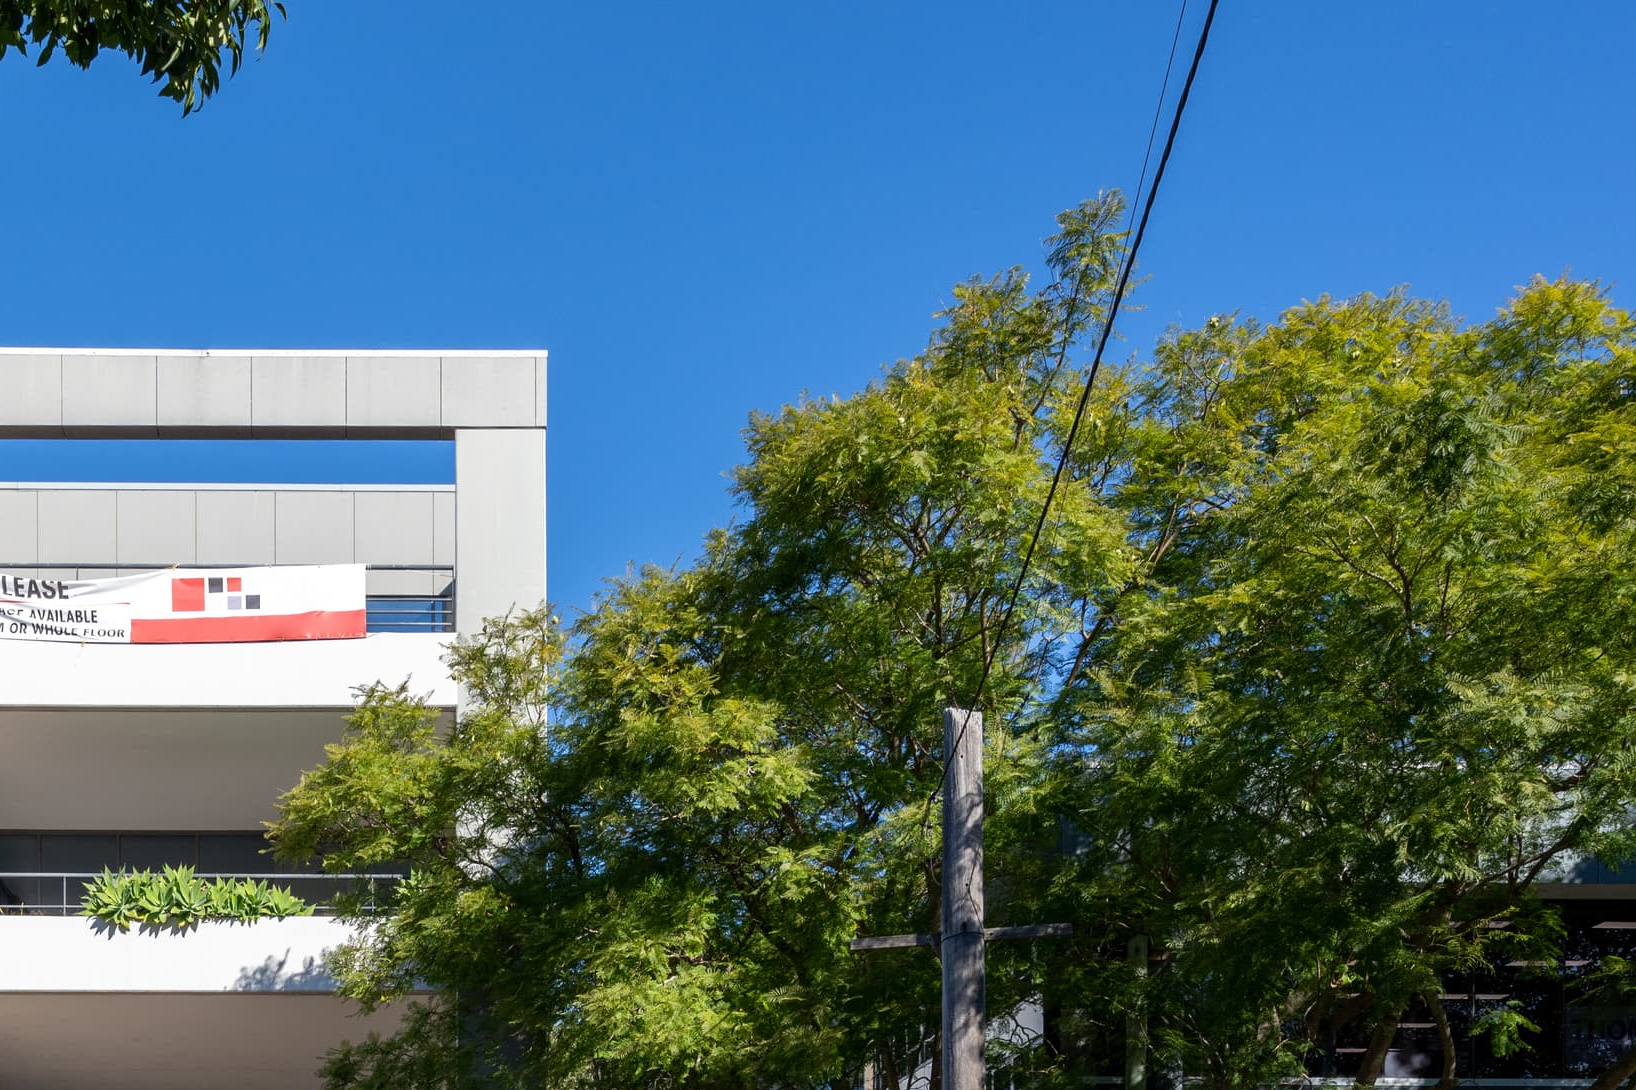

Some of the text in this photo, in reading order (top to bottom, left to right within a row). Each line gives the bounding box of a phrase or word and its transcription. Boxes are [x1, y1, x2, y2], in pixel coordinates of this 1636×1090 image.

[1, 575, 70, 600] LEASE
[29, 608, 99, 624] AVAILABLE
[9, 622, 28, 635] OR
[30, 622, 78, 637] WHOLE
[83, 628, 126, 638] FLOOR
